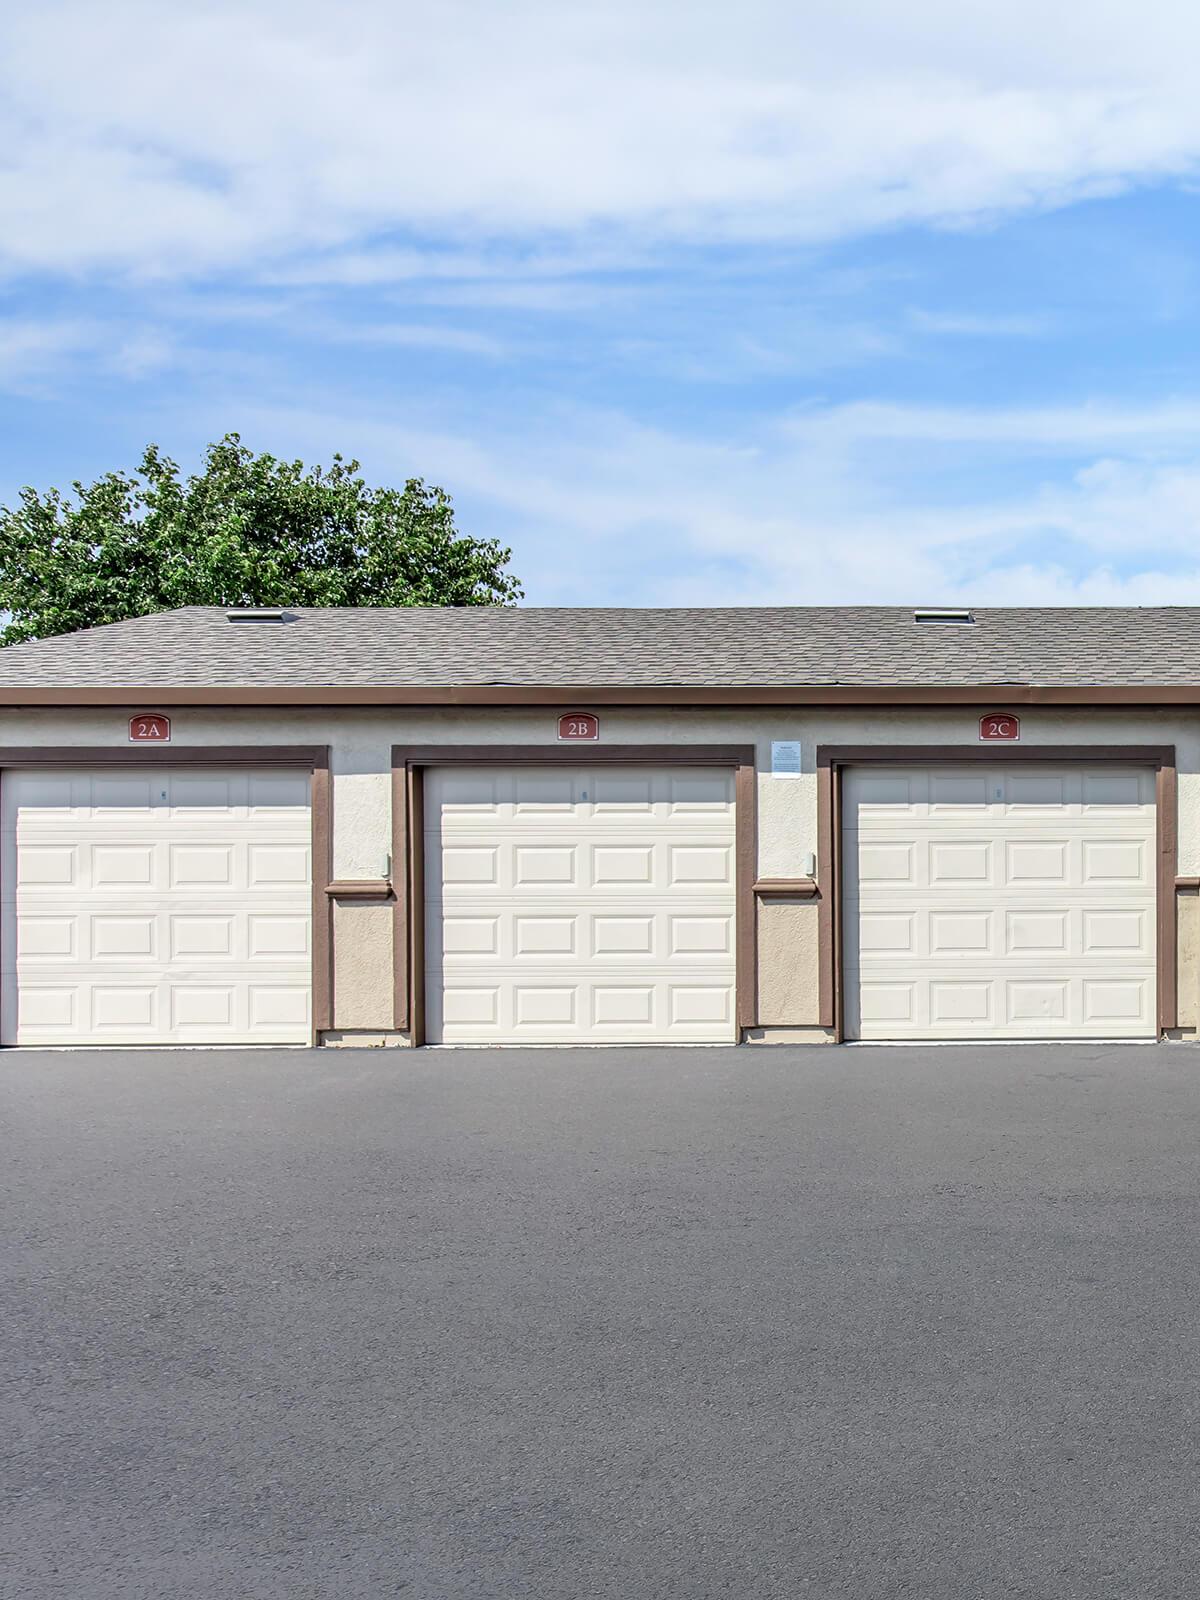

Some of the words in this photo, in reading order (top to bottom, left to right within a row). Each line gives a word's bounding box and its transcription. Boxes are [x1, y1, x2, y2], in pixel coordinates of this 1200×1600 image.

[138, 724, 161, 737] 2A
[568, 722, 588, 736] 2B
[989, 722, 1010, 736] 2C
